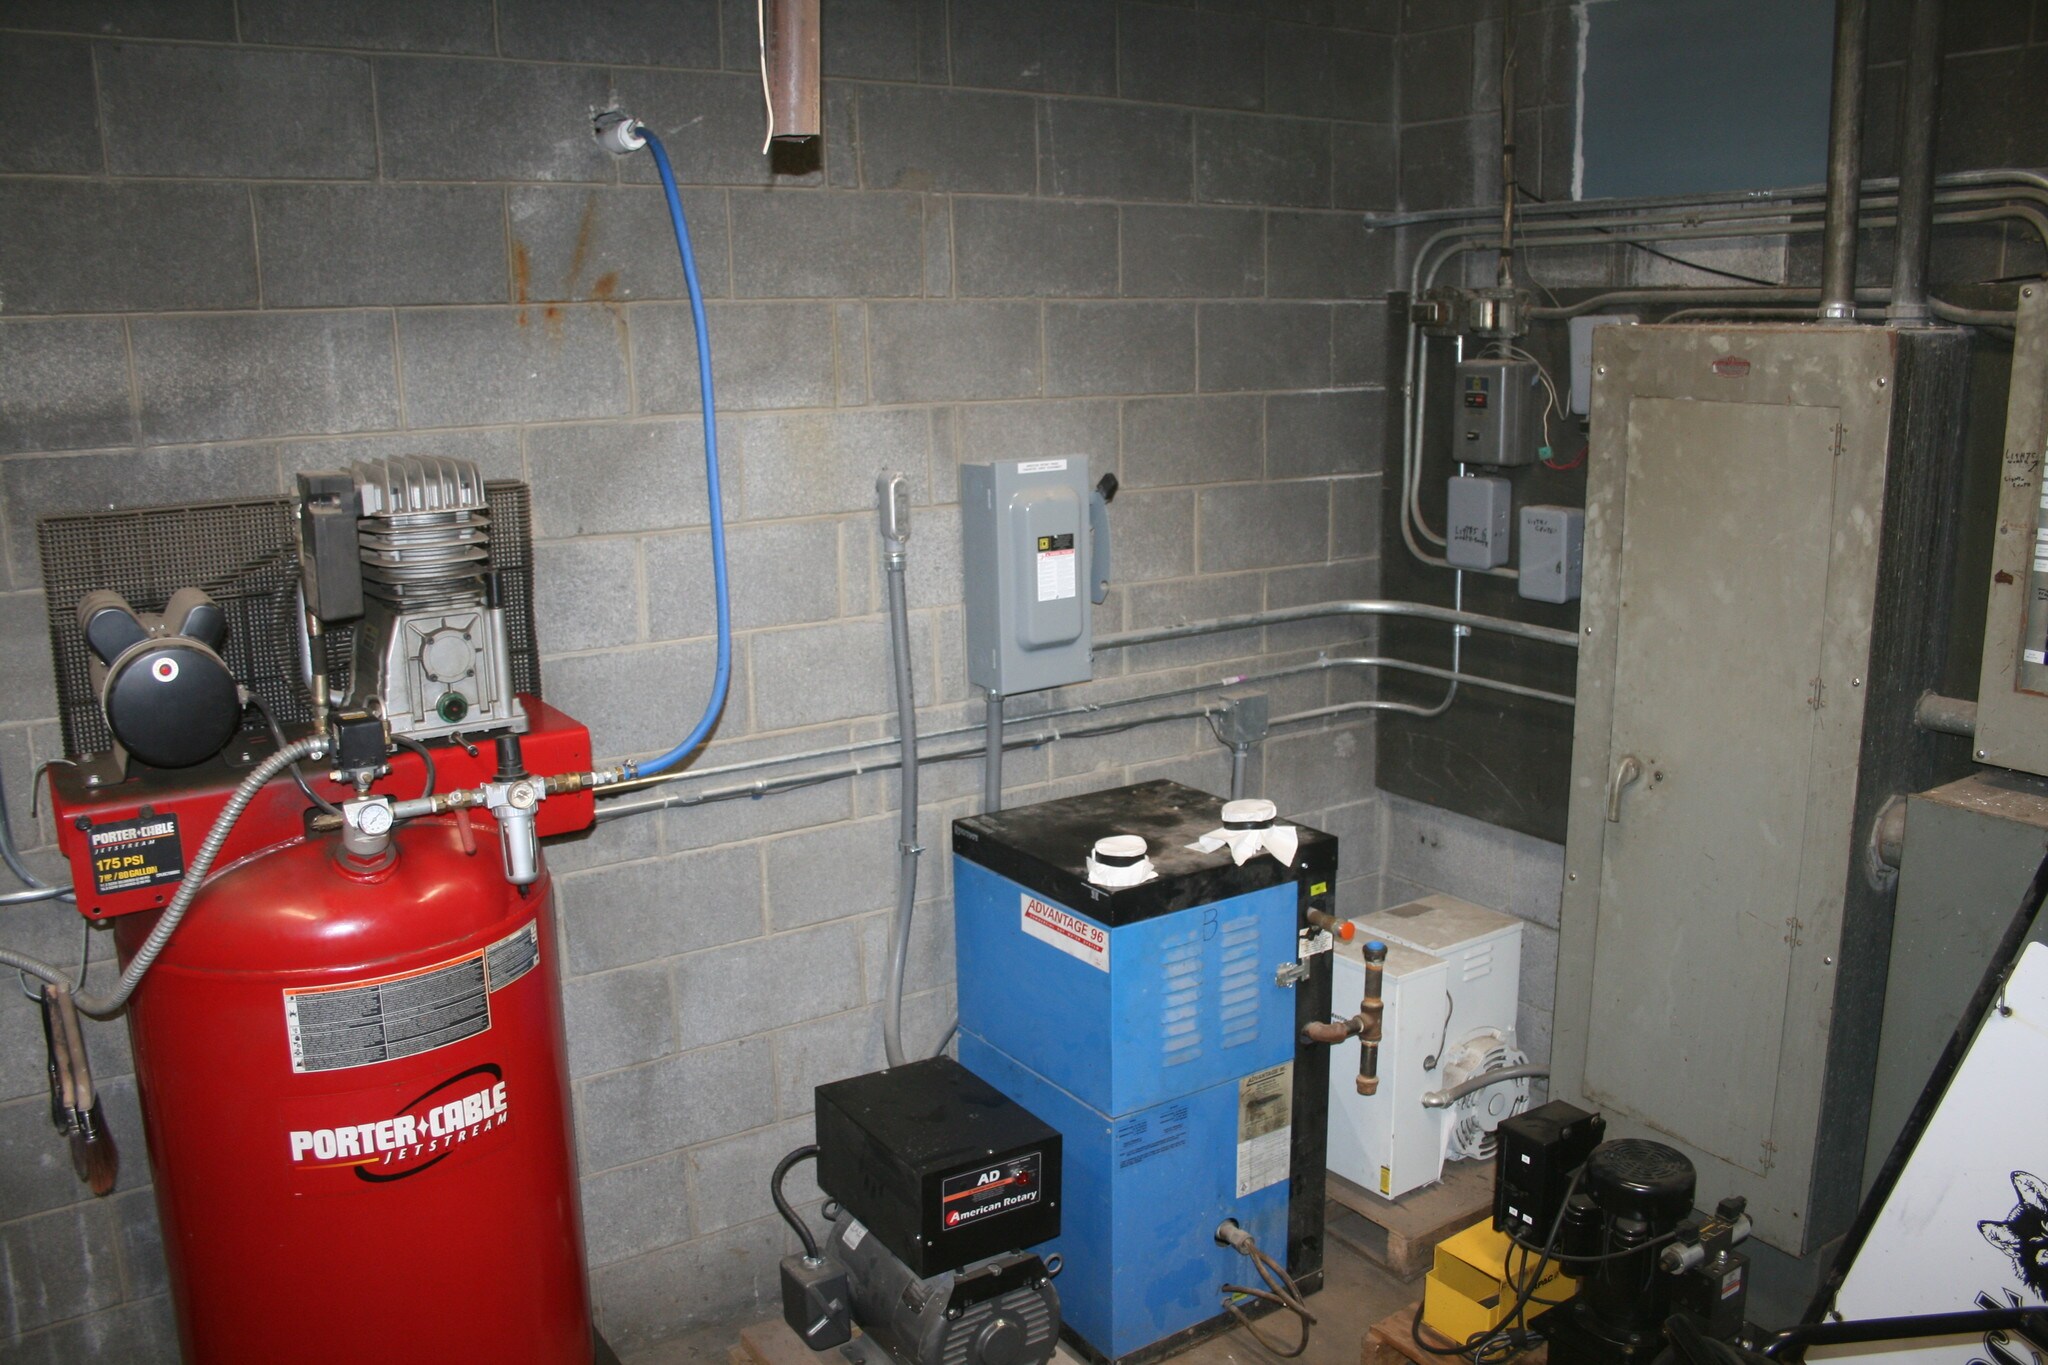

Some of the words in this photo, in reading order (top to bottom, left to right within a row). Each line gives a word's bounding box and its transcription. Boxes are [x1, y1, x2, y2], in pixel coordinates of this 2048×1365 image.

[92, 828, 137, 846] PORTER
[140, 822, 175, 837] CABLE
[94, 839, 155, 855] JETSTREAM
[96, 857, 121, 871] 175
[123, 855, 144, 867] PSI
[129, 866, 158, 878] GALLON
[1027, 900, 1088, 936] ADVANTAGE
[1090, 928, 1104, 943] 96
[1203, 907, 1218, 941] B
[290, 1115, 418, 1161] PORTER
[429, 1081, 508, 1138] CABLE
[384, 1111, 508, 1165] JETSTREAM
[977, 1169, 1000, 1187] AD
[949, 1202, 1001, 1224] American
[1003, 1190, 1038, 1207] Rotary
